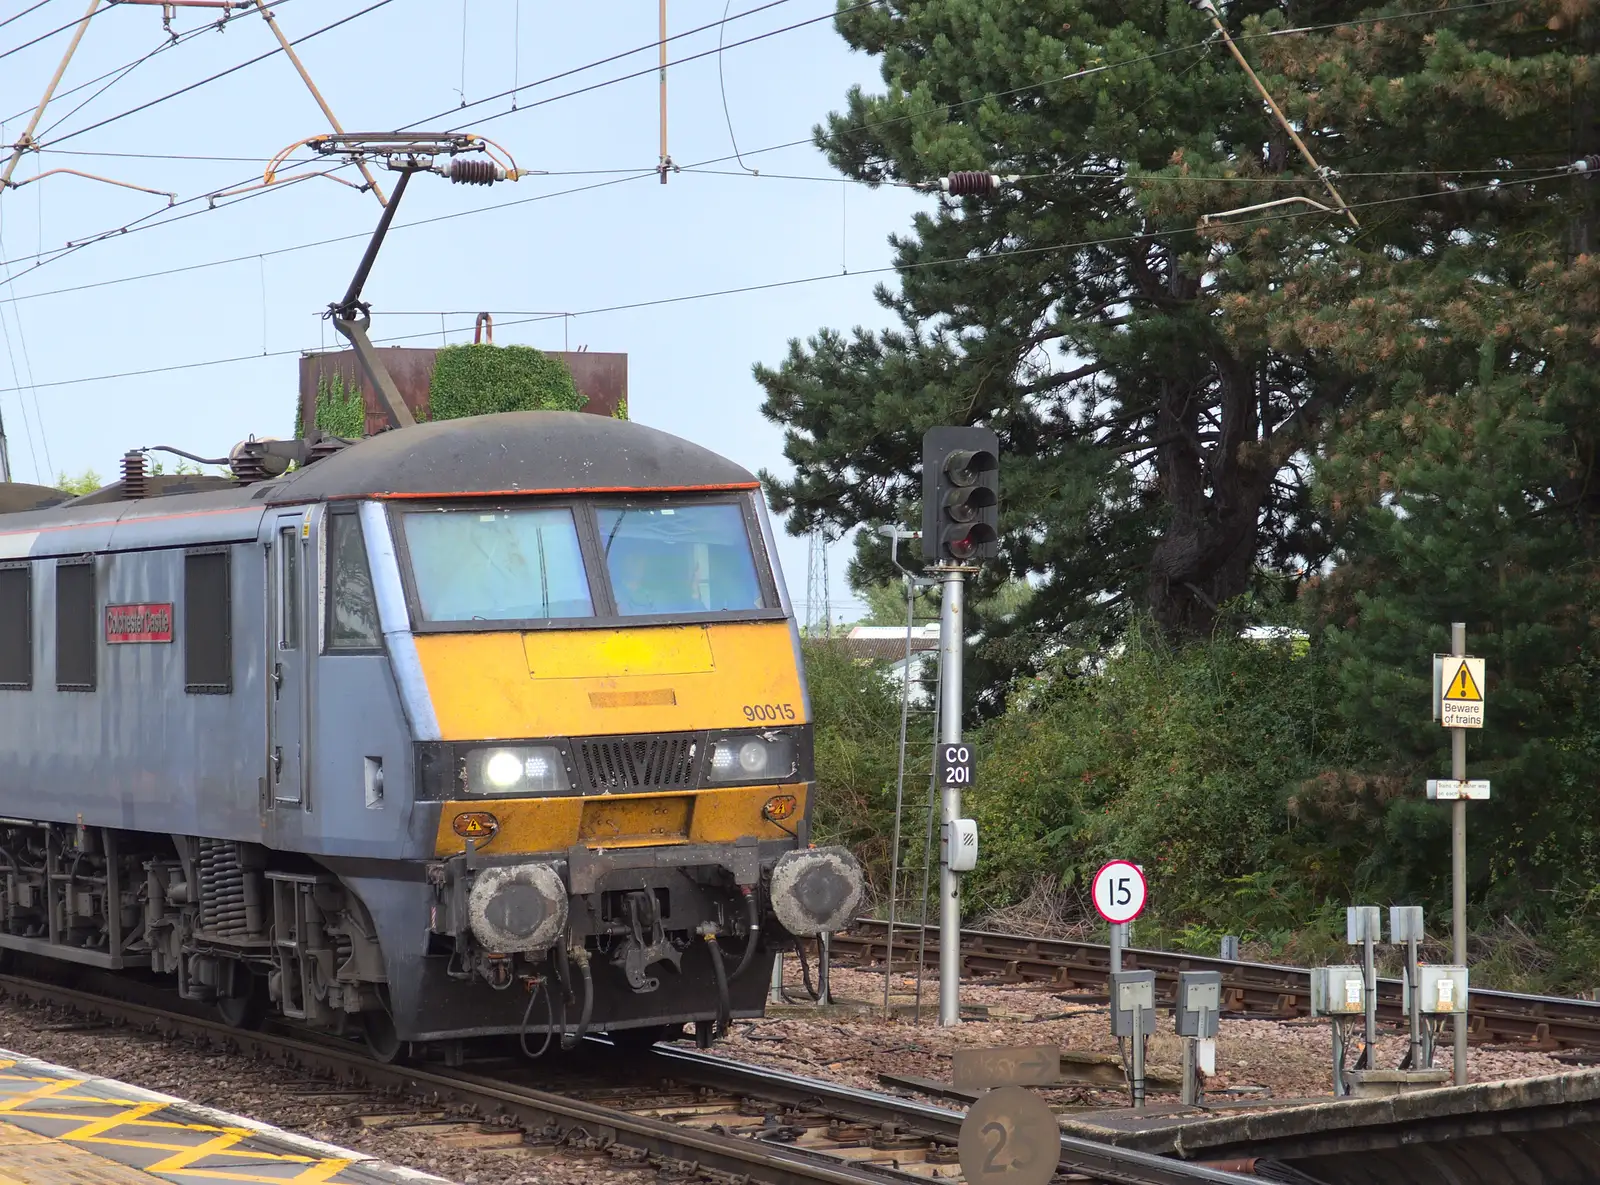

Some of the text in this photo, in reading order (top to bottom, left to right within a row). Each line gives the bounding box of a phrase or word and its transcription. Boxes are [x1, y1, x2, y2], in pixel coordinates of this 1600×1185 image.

[108, 608, 169, 634] Colchester Castle
[743, 704, 796, 721] 90015
[1445, 703, 1479, 713] Beware
[1445, 714, 1482, 724] of trains
[946, 747, 969, 763] CO
[946, 766, 970, 783] 201
[1109, 878, 1131, 906] 15
[981, 1117, 1039, 1173] 25
